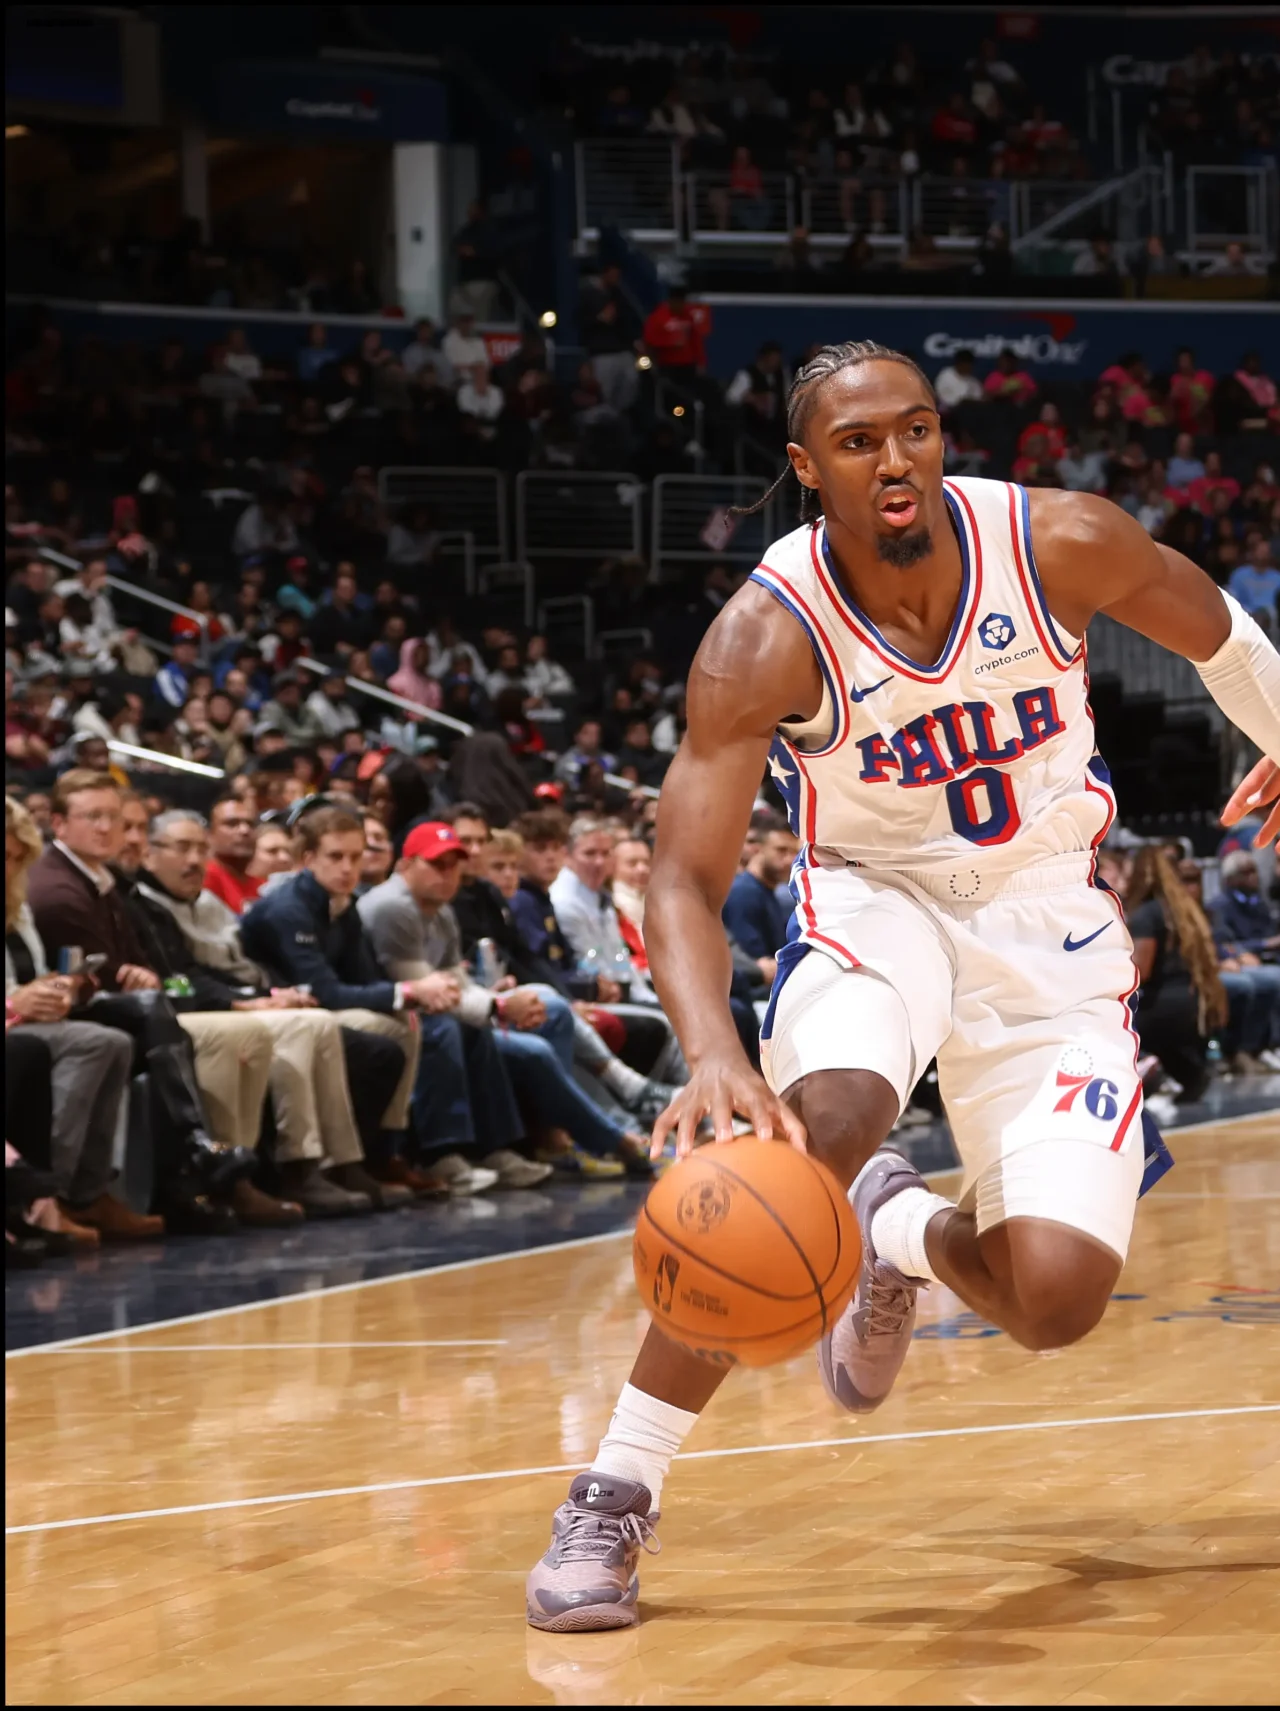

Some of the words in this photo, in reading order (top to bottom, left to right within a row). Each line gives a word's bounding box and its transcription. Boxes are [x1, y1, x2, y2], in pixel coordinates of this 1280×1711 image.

[974, 646, 1040, 675] crypto.com
[855, 686, 1067, 789] PHILA
[945, 767, 1021, 847] 0
[1052, 1069, 1119, 1122] 76
